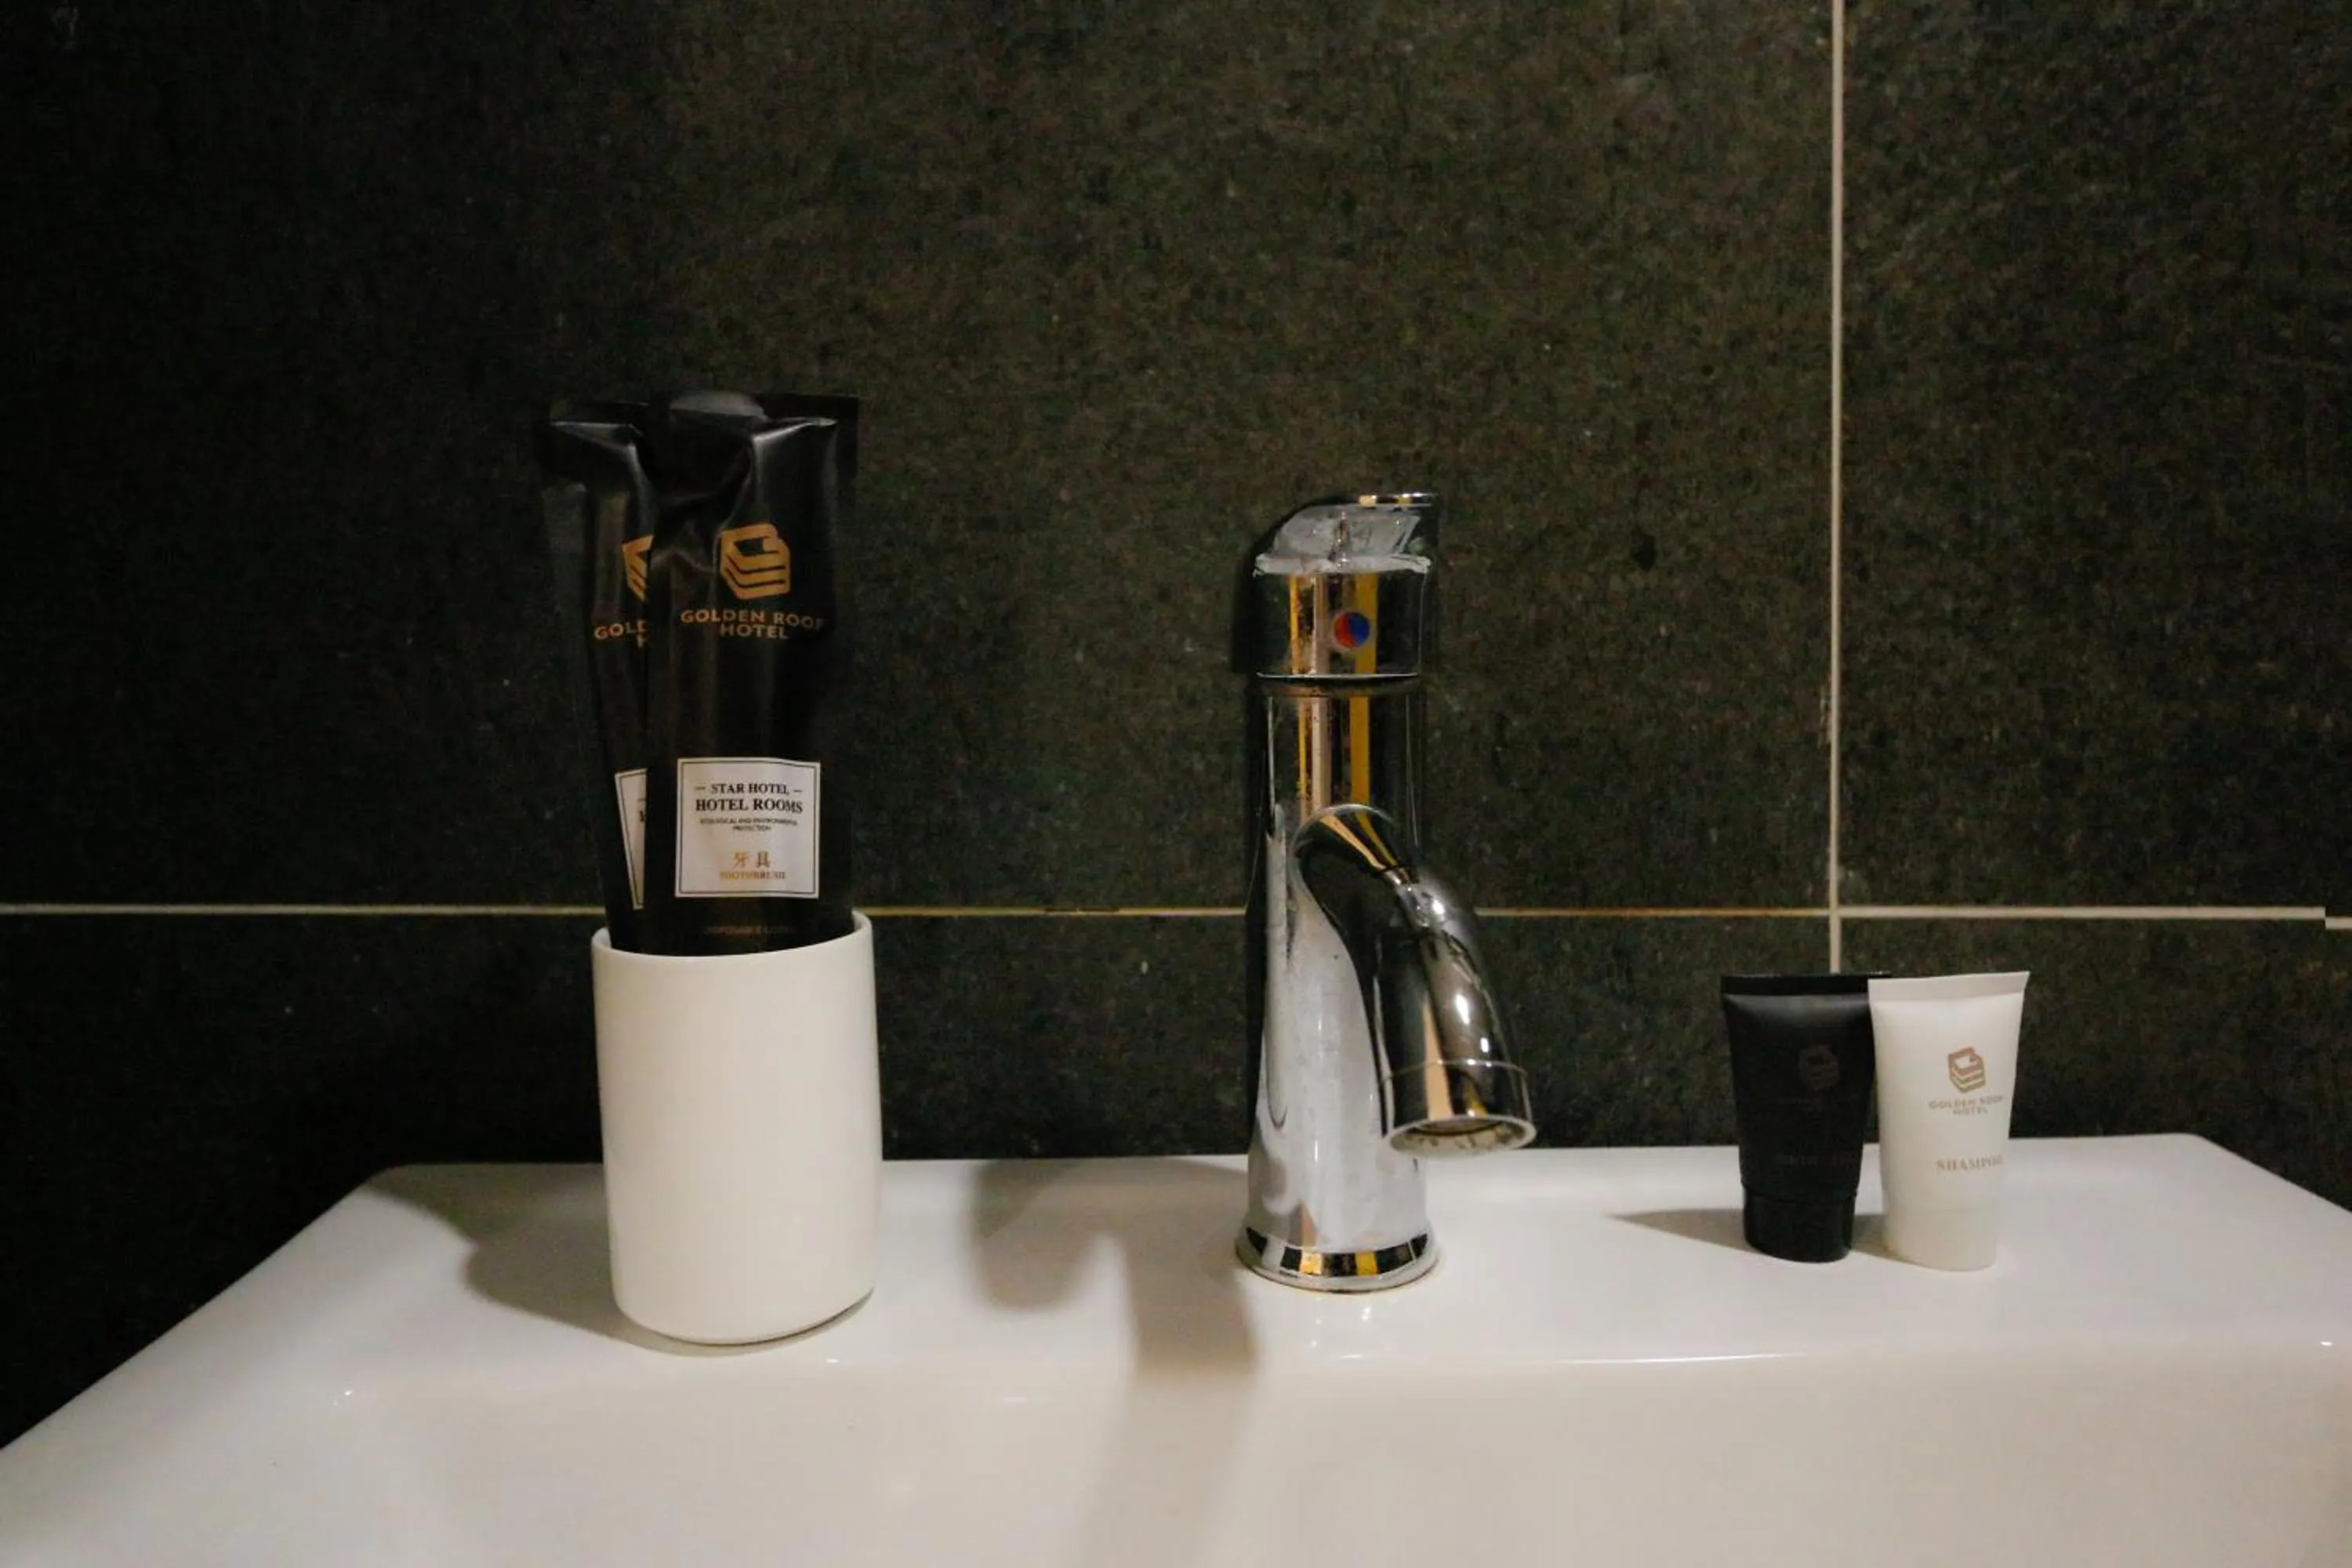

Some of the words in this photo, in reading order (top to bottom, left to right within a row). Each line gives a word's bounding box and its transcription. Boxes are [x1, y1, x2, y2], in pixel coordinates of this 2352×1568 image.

[681, 608, 766, 623] GOLDEN
[720, 624, 789, 639] HOTEL
[711, 783, 744, 794] STAR
[749, 783, 789, 795] HOTEL
[695, 799, 749, 811] HOTEL
[753, 799, 803, 814] ROOMS
